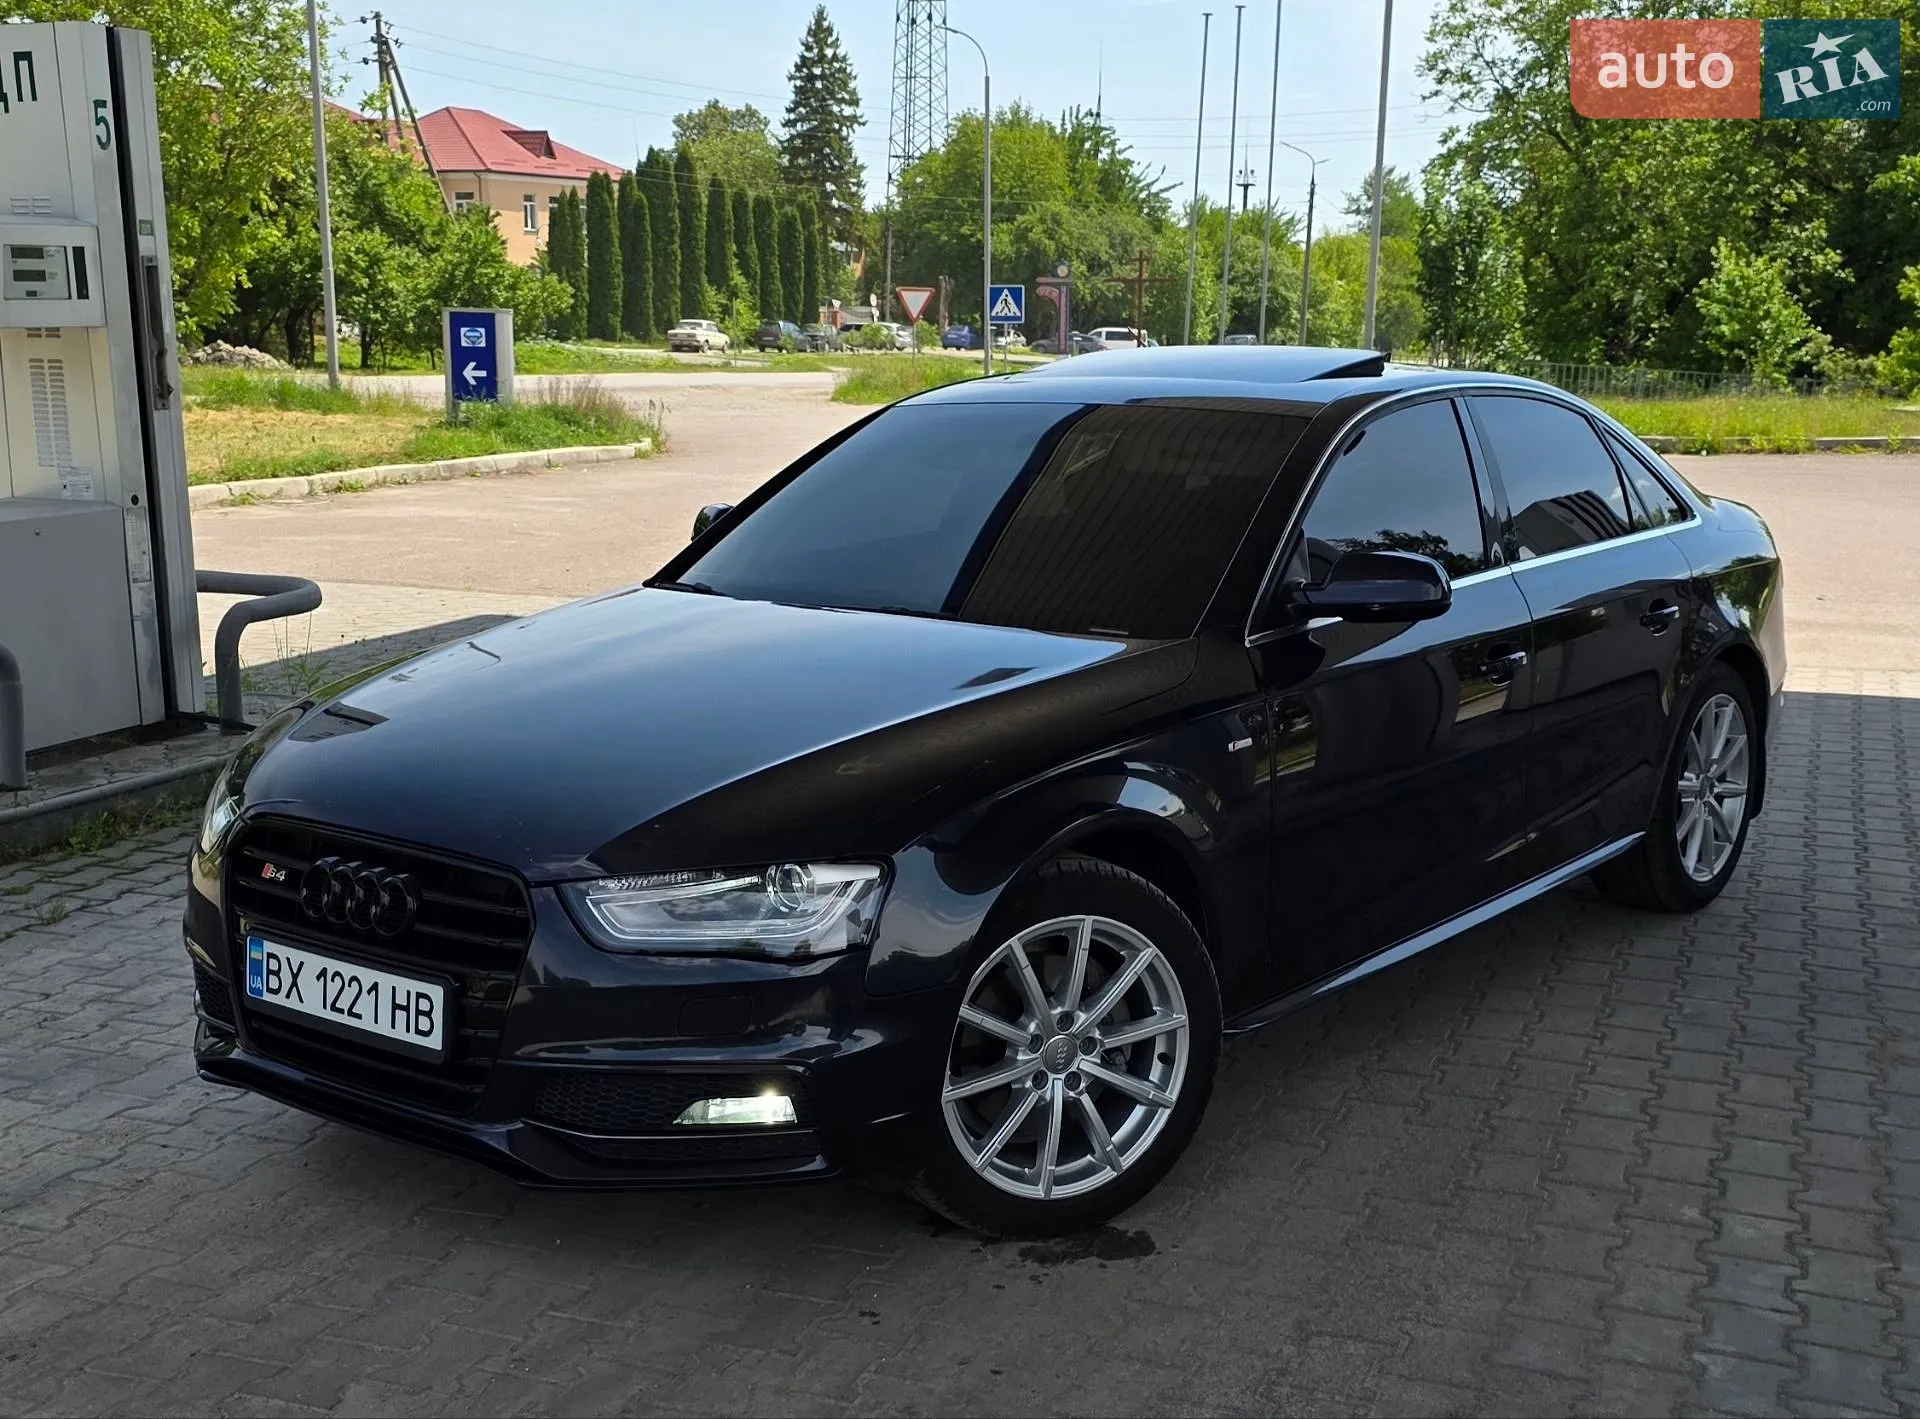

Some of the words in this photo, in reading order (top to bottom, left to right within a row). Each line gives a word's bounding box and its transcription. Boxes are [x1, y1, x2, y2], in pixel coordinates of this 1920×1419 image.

[0, 51, 38, 114] П
[93, 99, 112, 151] 5
[262, 863, 286, 881] S4
[250, 974, 263, 991] UA
[265, 951, 305, 1004] BX
[315, 967, 379, 1025] 1221
[390, 985, 435, 1038] HB
